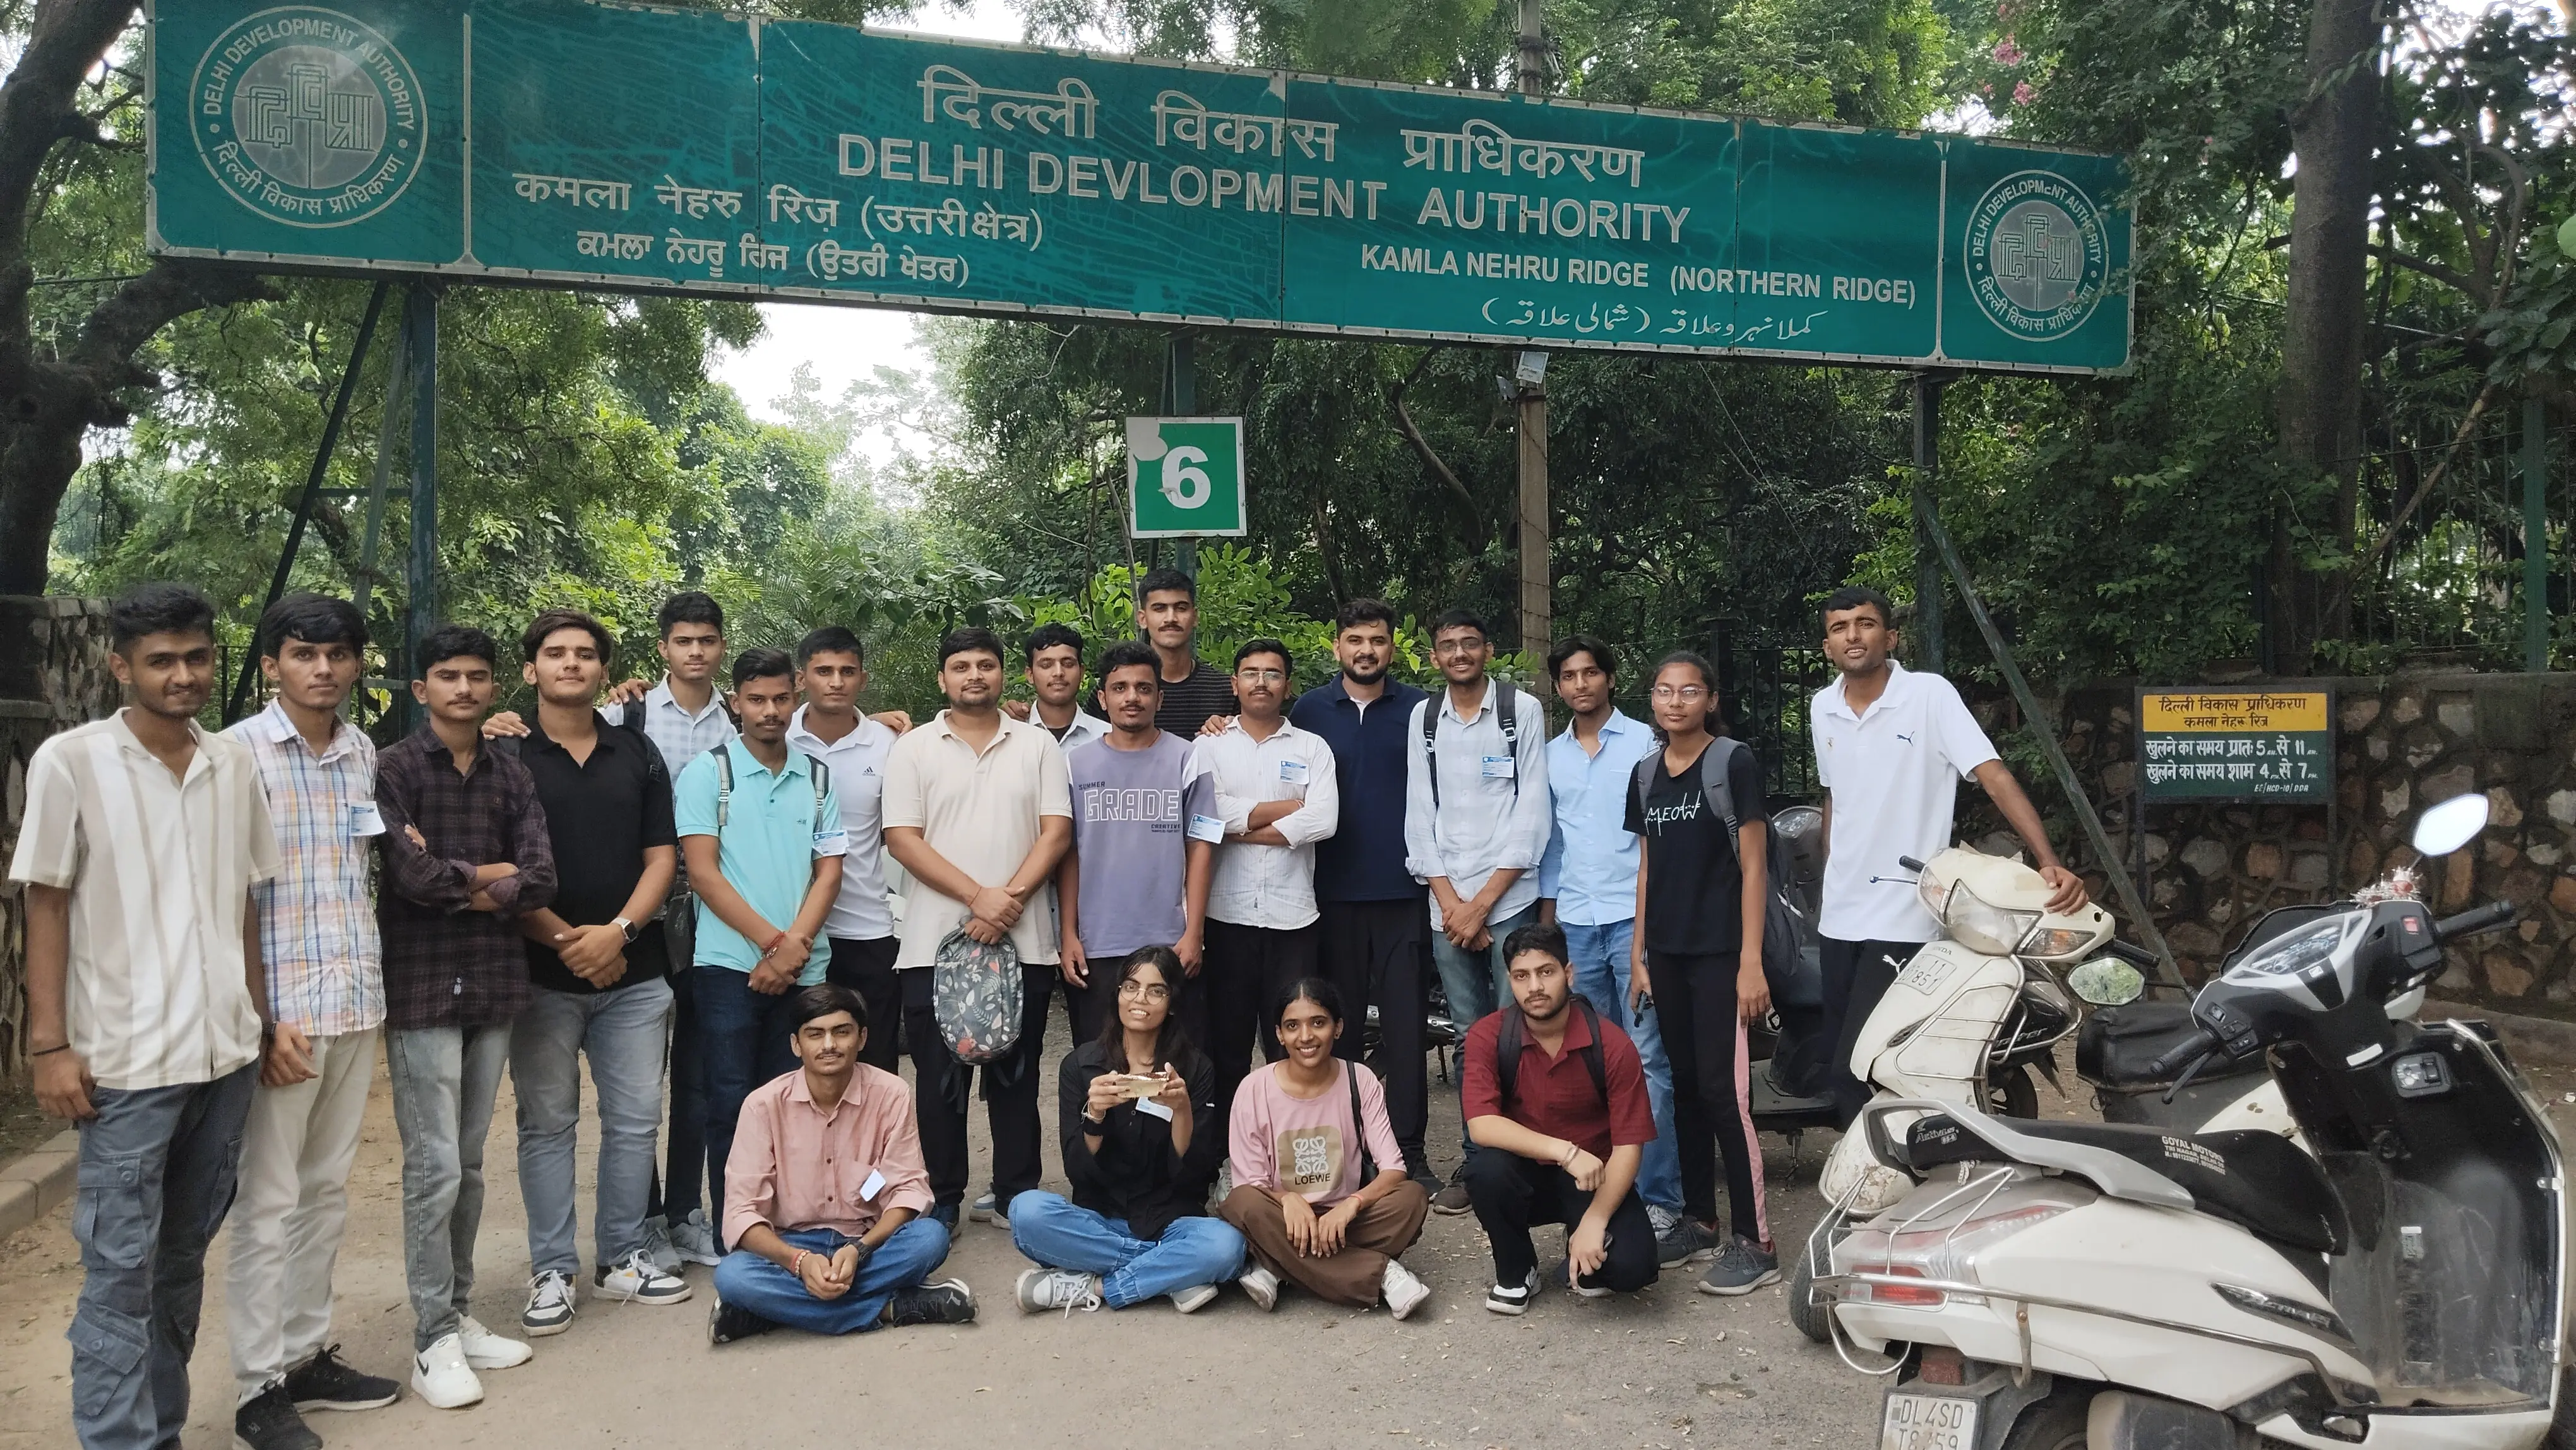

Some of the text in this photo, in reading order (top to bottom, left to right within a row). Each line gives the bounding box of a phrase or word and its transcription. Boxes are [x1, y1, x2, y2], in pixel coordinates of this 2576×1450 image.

[204, 18, 414, 130] DELHI DEVELOPMENT AUTHORITY
[917, 65, 1645, 187] दिल्ली विकास प्राधिकरण
[213, 140, 405, 215] दिल्ली विकास प्राधिकरण
[512, 173, 632, 210] कमला
[839, 133, 1690, 243] DELHI DEVLOPMENT AUTHORITY
[577, 231, 654, 260] ਕਮਲਾ
[665, 227, 727, 278] ਨੇਹਰੂ
[1973, 213, 1992, 256] DELHI
[1362, 244, 1915, 309] KAMLA NEHRU RIDGE (NORTHERN RIDGE)
[1977, 274, 2010, 316] दिल्ली
[2005, 306, 2045, 332] विकास
[1162, 445, 1212, 510] 6
[2159, 695, 2307, 713] दिल्ली विकास प्राधिकरण
[2183, 716, 2219, 728] कमला
[2248, 713, 2269, 728] रिज
[2145, 736, 2178, 760] खुलने
[2178, 740, 2195, 756] का
[2196, 740, 2225, 757] समय
[2256, 740, 2266, 756] 5
[2275, 734, 2291, 756] से
[2295, 740, 2305, 756] 11
[1078, 781, 1106, 790] SUMMER
[2146, 759, 2178, 784] खुलने
[2178, 763, 2195, 780] का
[2196, 763, 2226, 780] समय
[2227, 763, 2256, 781] शाम
[2259, 763, 2270, 779] 4
[2279, 758, 2293, 780] से
[2298, 762, 2308, 779] 7
[1084, 789, 1179, 822] GRADE
[1644, 789, 1702, 837] MEOW
[2161, 1135, 2224, 1163] GOYAL MOTORS
[1294, 1173, 1331, 1185] LOEWE
[1900, 1399, 1964, 1430] DL4SD
